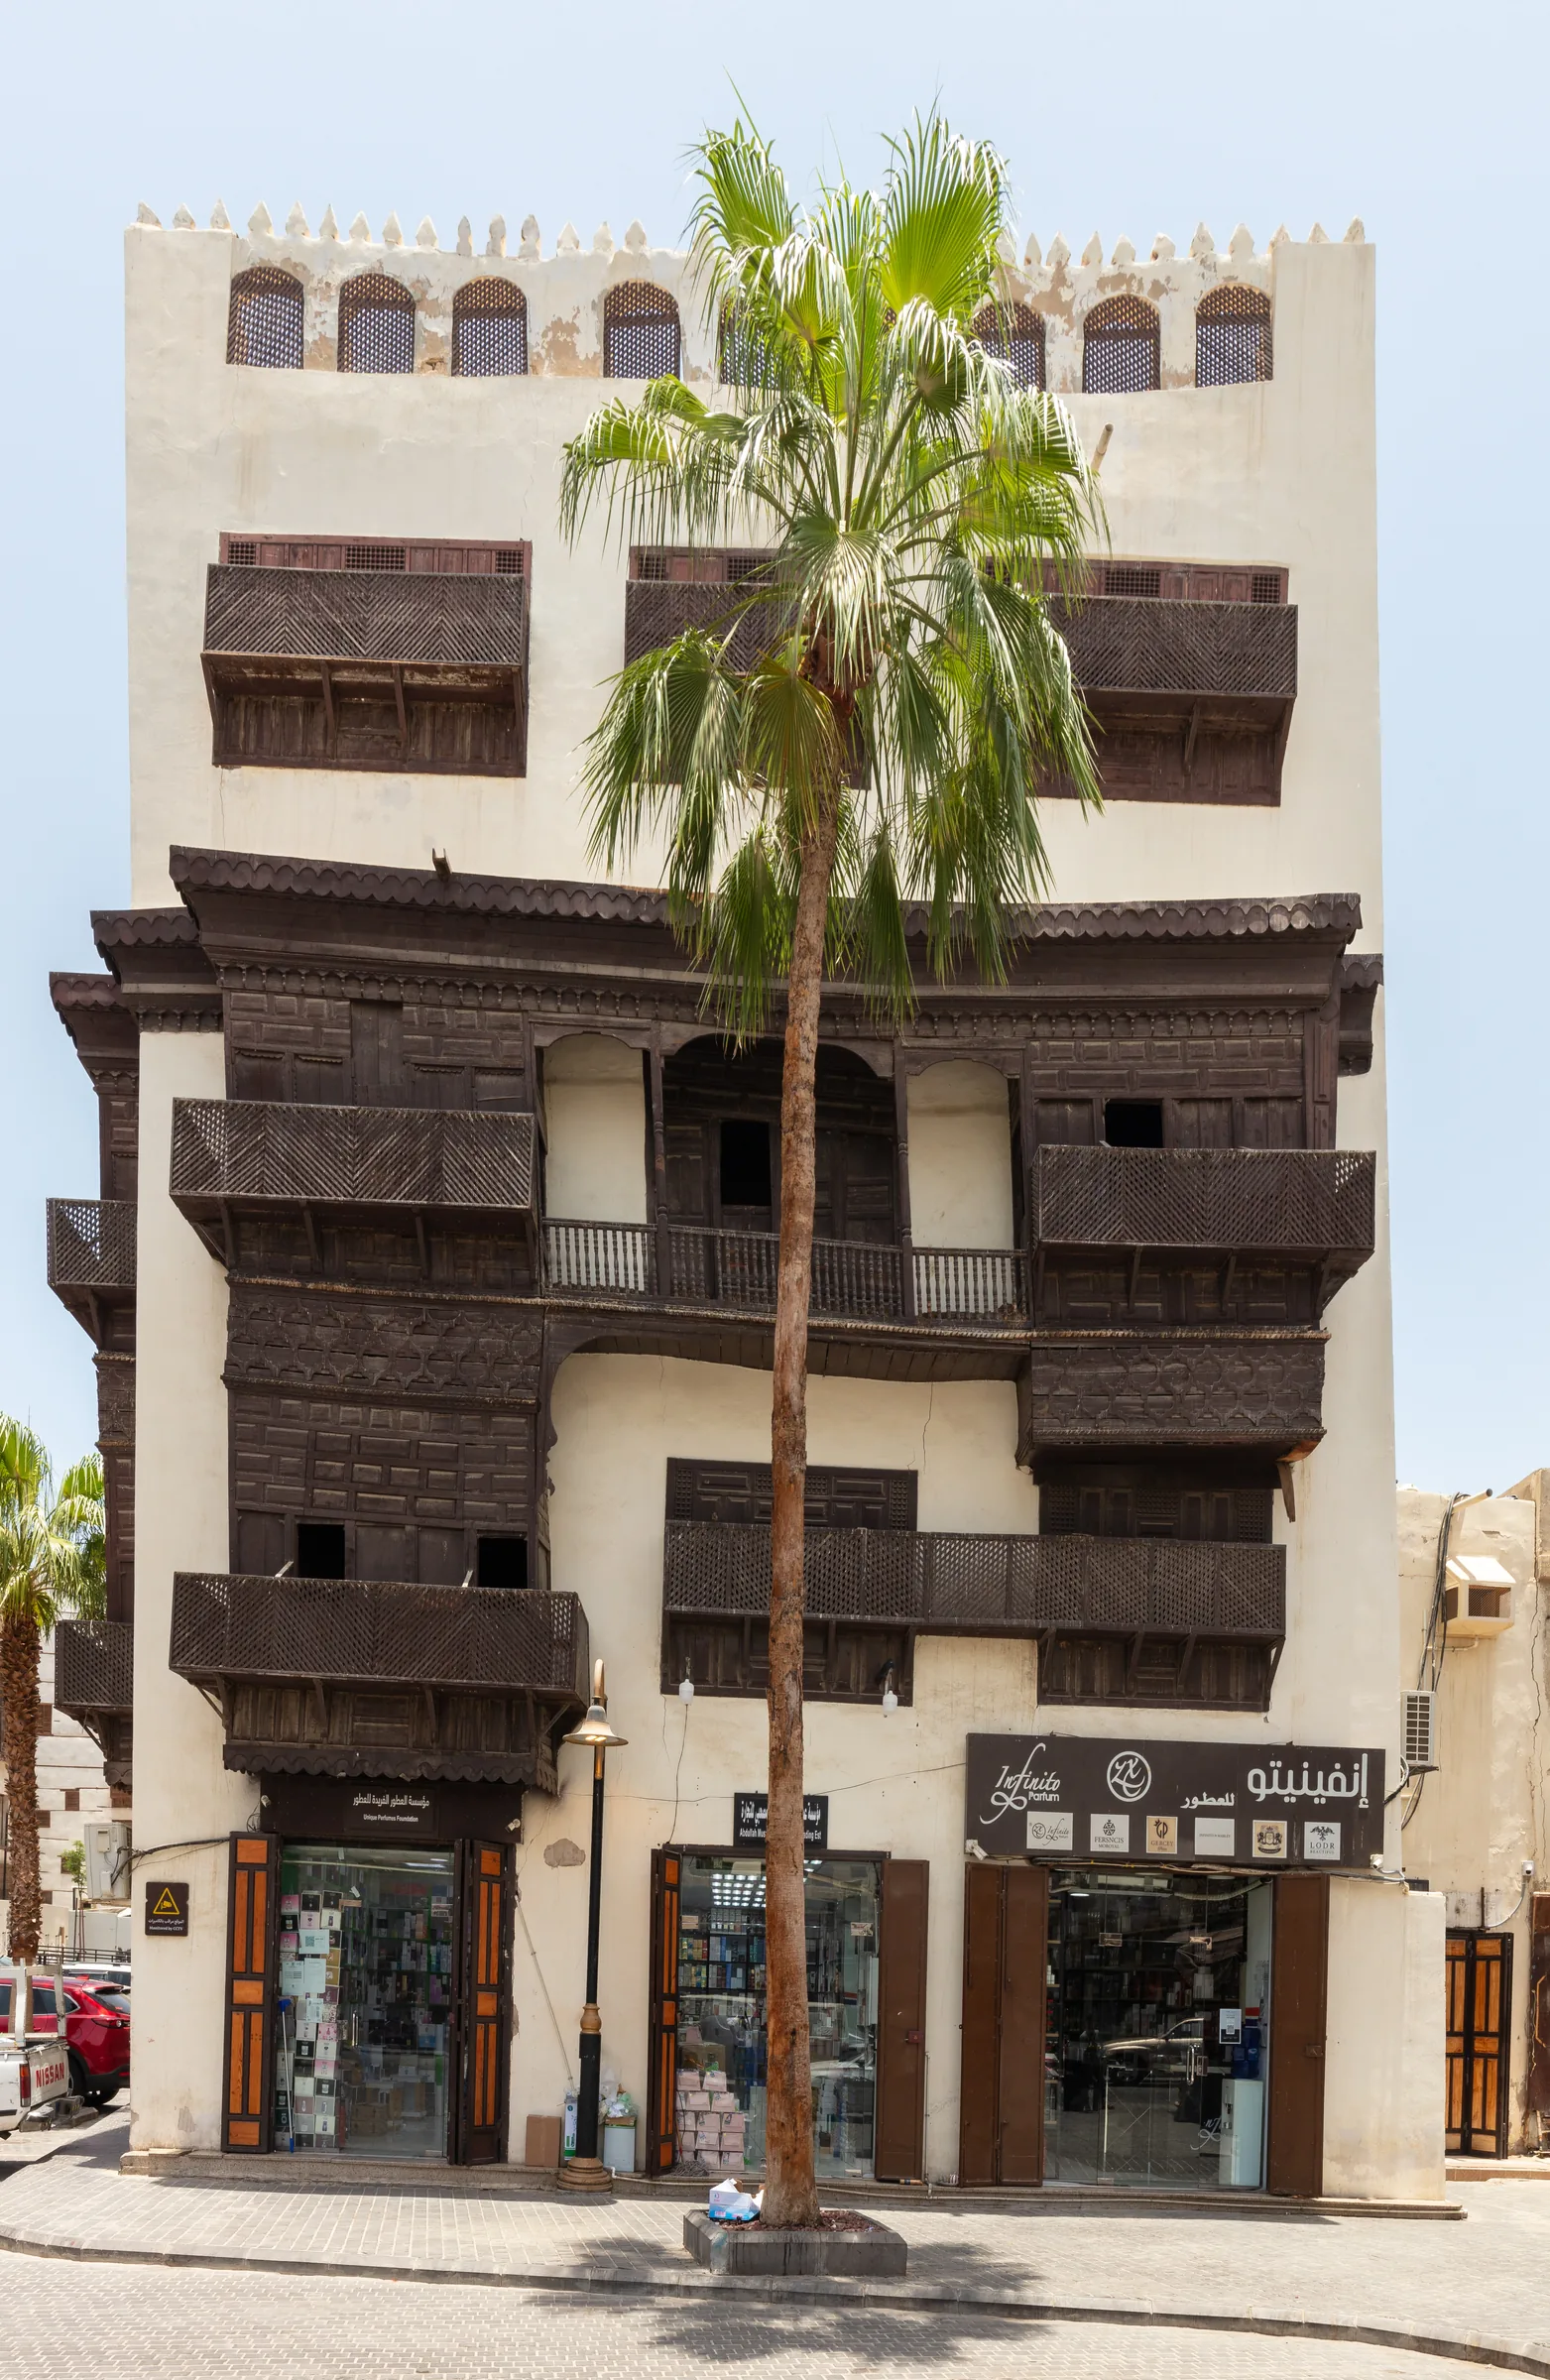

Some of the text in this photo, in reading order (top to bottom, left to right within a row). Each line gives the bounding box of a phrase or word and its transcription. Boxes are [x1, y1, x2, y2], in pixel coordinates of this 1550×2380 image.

[979, 1742, 1061, 1825] Infinito
[1180, 1752, 1370, 1809] إنفينيتو للعطور
[353, 1793, 430, 1809] مؤسسة العطور الفريدة للعطور
[1027, 1790, 1060, 1802] Parfum
[739, 1828, 757, 1838] Abdullah
[36, 2063, 65, 2088] NISSAN
